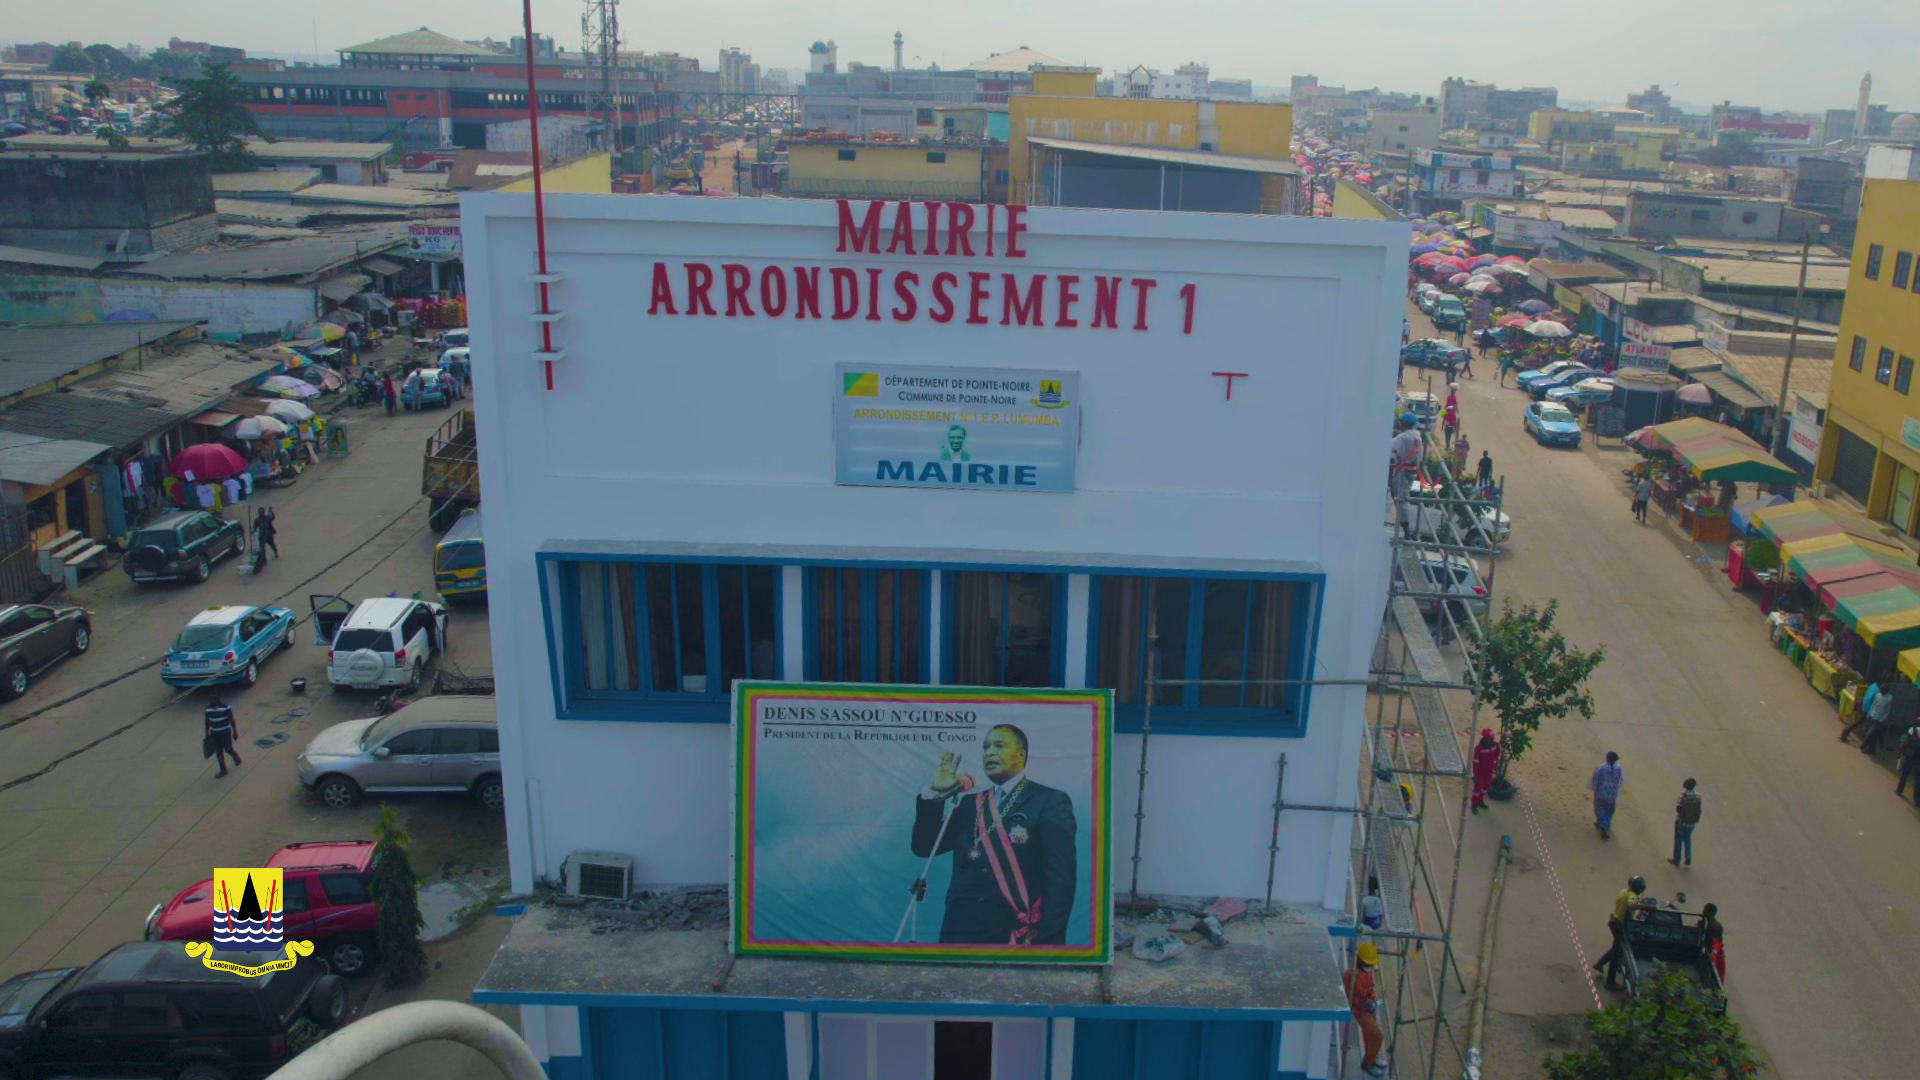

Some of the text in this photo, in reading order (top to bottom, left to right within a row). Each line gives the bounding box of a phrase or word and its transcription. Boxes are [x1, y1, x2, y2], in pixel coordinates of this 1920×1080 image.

[837, 200, 1026, 258] MAIRIE
[648, 263, 1195, 333] ARRONDISSEMENT 1
[1625, 344, 1667, 356] ATLANTIS
[885, 374, 949, 389] DÉPARTEMENT
[951, 379, 963, 389] DE
[898, 391, 944, 402] COMMUNE
[853, 408, 957, 423] ARRONDISSEMENT
[1003, 413, 1060, 426] LUMUMBA
[876, 460, 1037, 485] MAIRIE
[764, 706, 976, 725] DENIS SASSOU N'GUESSO
